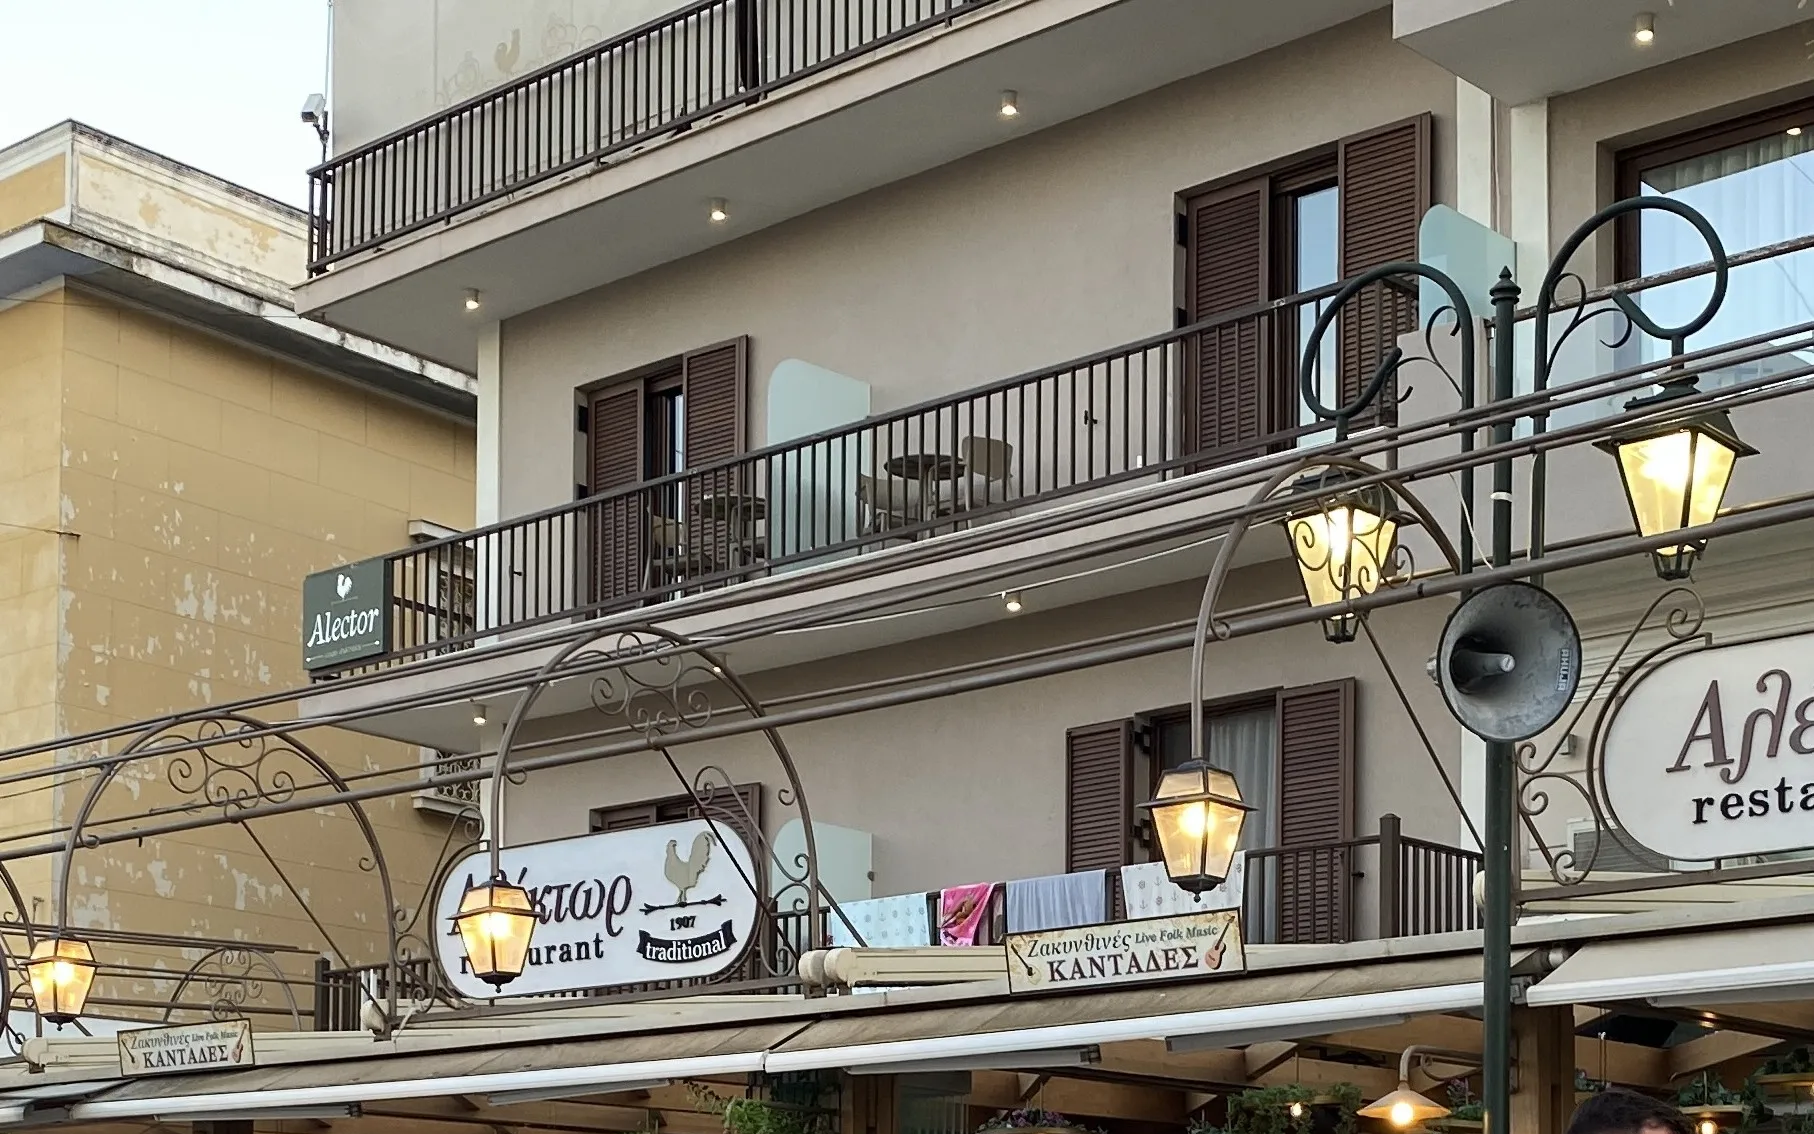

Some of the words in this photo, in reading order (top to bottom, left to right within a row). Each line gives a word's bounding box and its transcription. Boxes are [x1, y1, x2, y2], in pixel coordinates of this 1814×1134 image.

[307, 608, 379, 647] Alector
[1557, 649, 1570, 691] AHUJA
[670, 916, 696, 931] 1907
[1135, 932, 1156, 943] Live
[1160, 929, 1182, 941] Folk
[1186, 925, 1217, 939] Music
[459, 932, 604, 974] rurant
[646, 931, 727, 961] traditional
[1028, 930, 1131, 957] Ζακυνθινές
[1048, 946, 1198, 982] ΚΑΝΤΑΔΕΣ
[131, 1032, 190, 1049] Ζακυνθινές
[143, 1045, 228, 1068] ΚΑΝΤΑΔΕΣ
